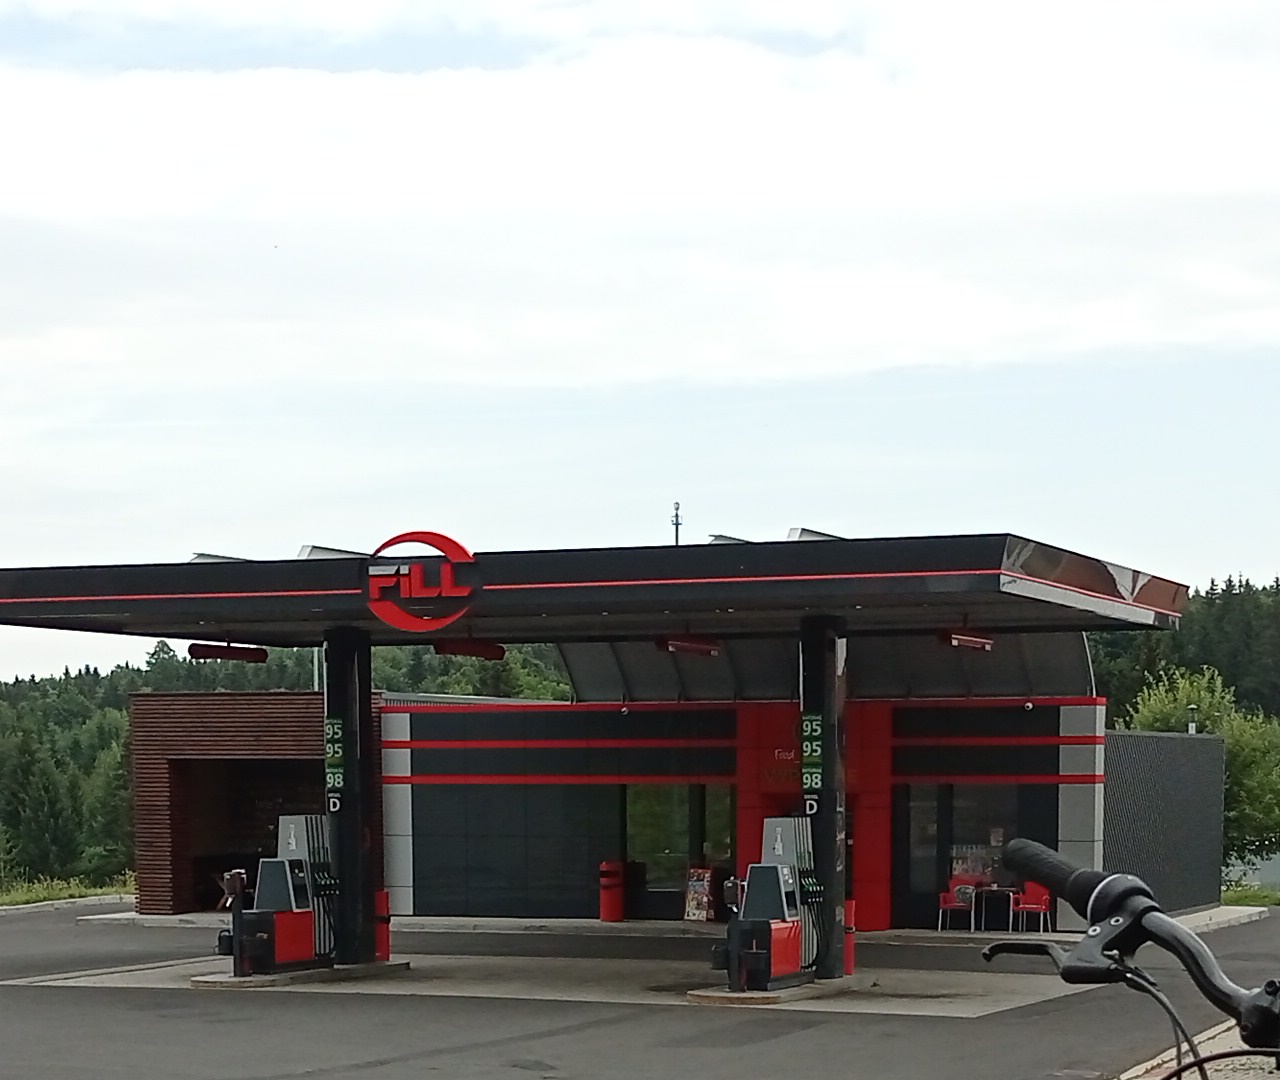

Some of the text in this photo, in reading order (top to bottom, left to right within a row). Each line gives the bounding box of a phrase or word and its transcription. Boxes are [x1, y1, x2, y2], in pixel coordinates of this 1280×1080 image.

[326, 725, 342, 738] 95
[803, 721, 821, 736] 95
[326, 744, 343, 757] 95
[803, 741, 821, 756] 95
[326, 773, 344, 788] 98
[803, 773, 822, 789] 98
[330, 798, 340, 812] D
[806, 800, 818, 815] D
